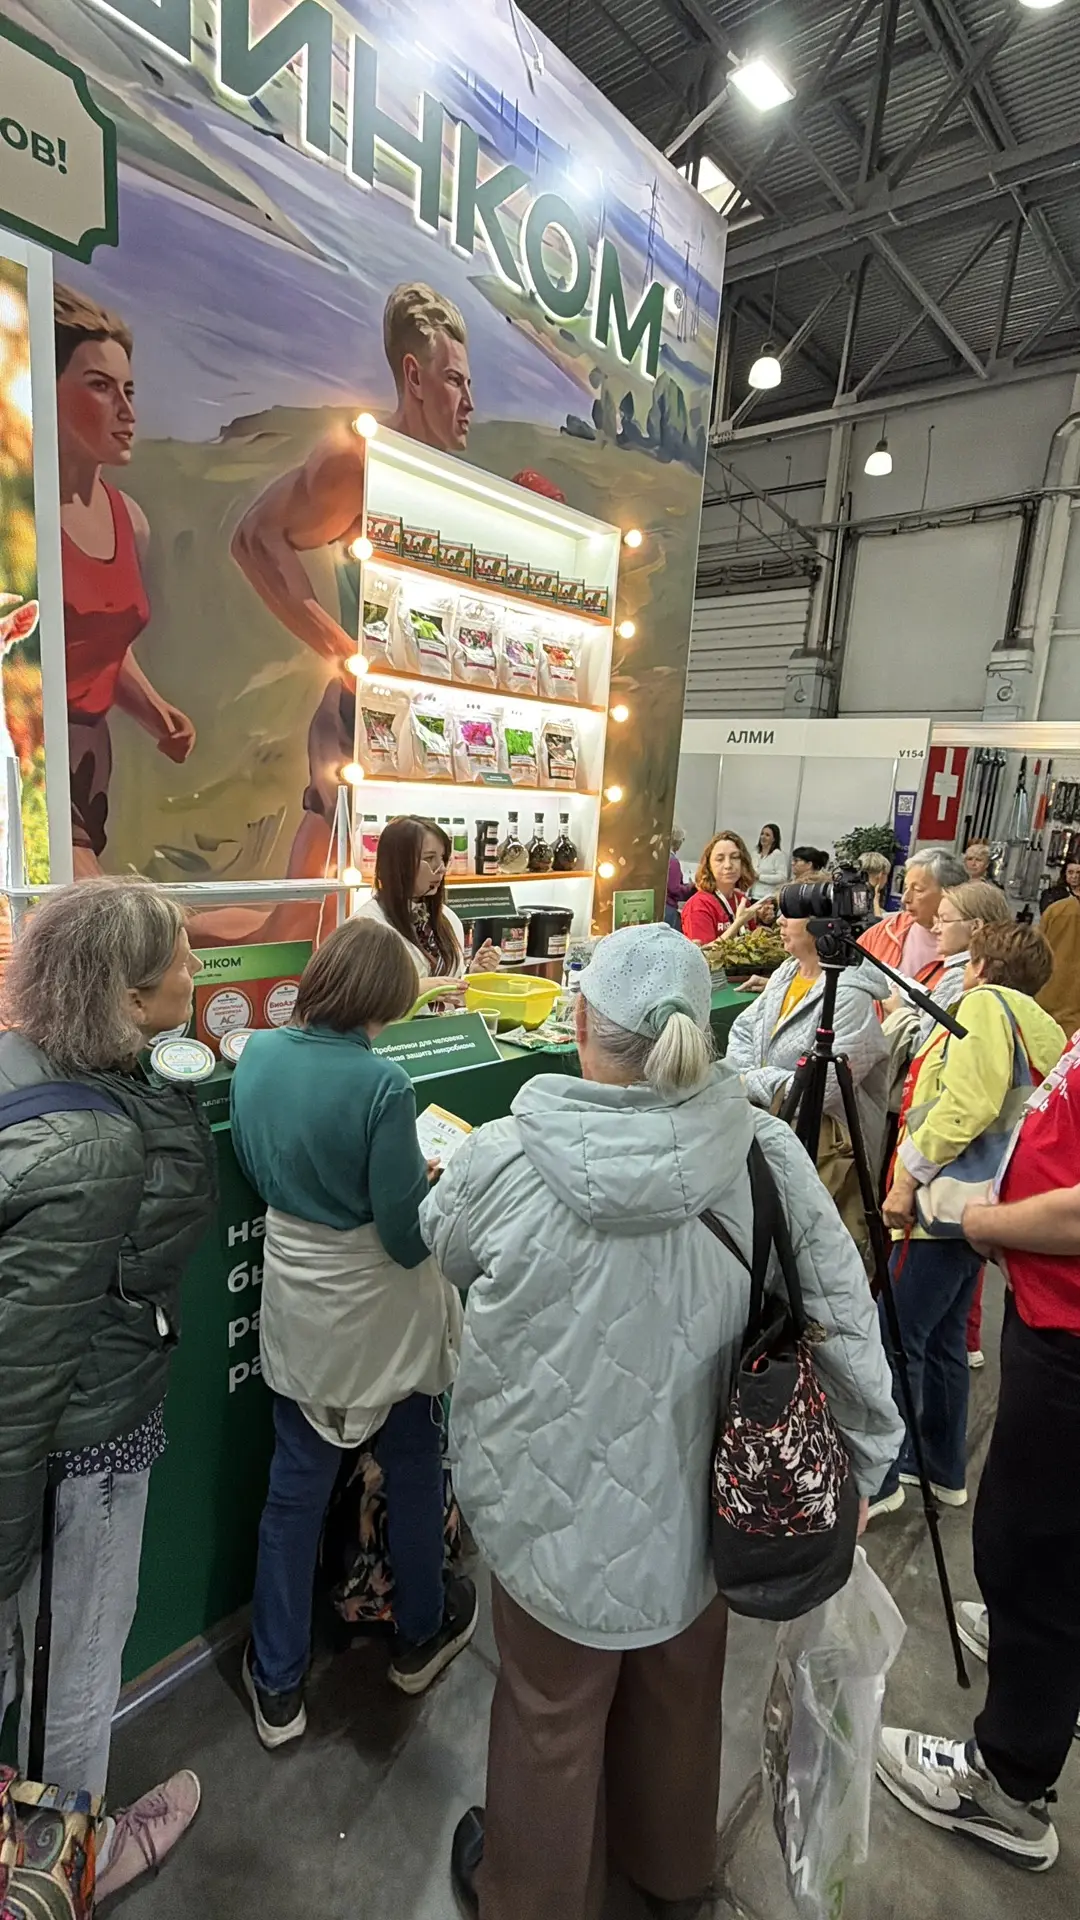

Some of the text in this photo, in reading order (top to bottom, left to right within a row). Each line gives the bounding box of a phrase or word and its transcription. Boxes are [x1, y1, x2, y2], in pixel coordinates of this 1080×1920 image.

[0, 117, 67, 174] ОВ!
[726, 731, 775, 744] АЛМИ
[899, 749, 924, 758] V154
[372, 1043, 418, 1055] Пробиотики
[419, 1040, 432, 1049] для
[432, 1034, 464, 1044] человека
[406, 1050, 432, 1060] защита
[432, 1042, 476, 1053] микробиома
